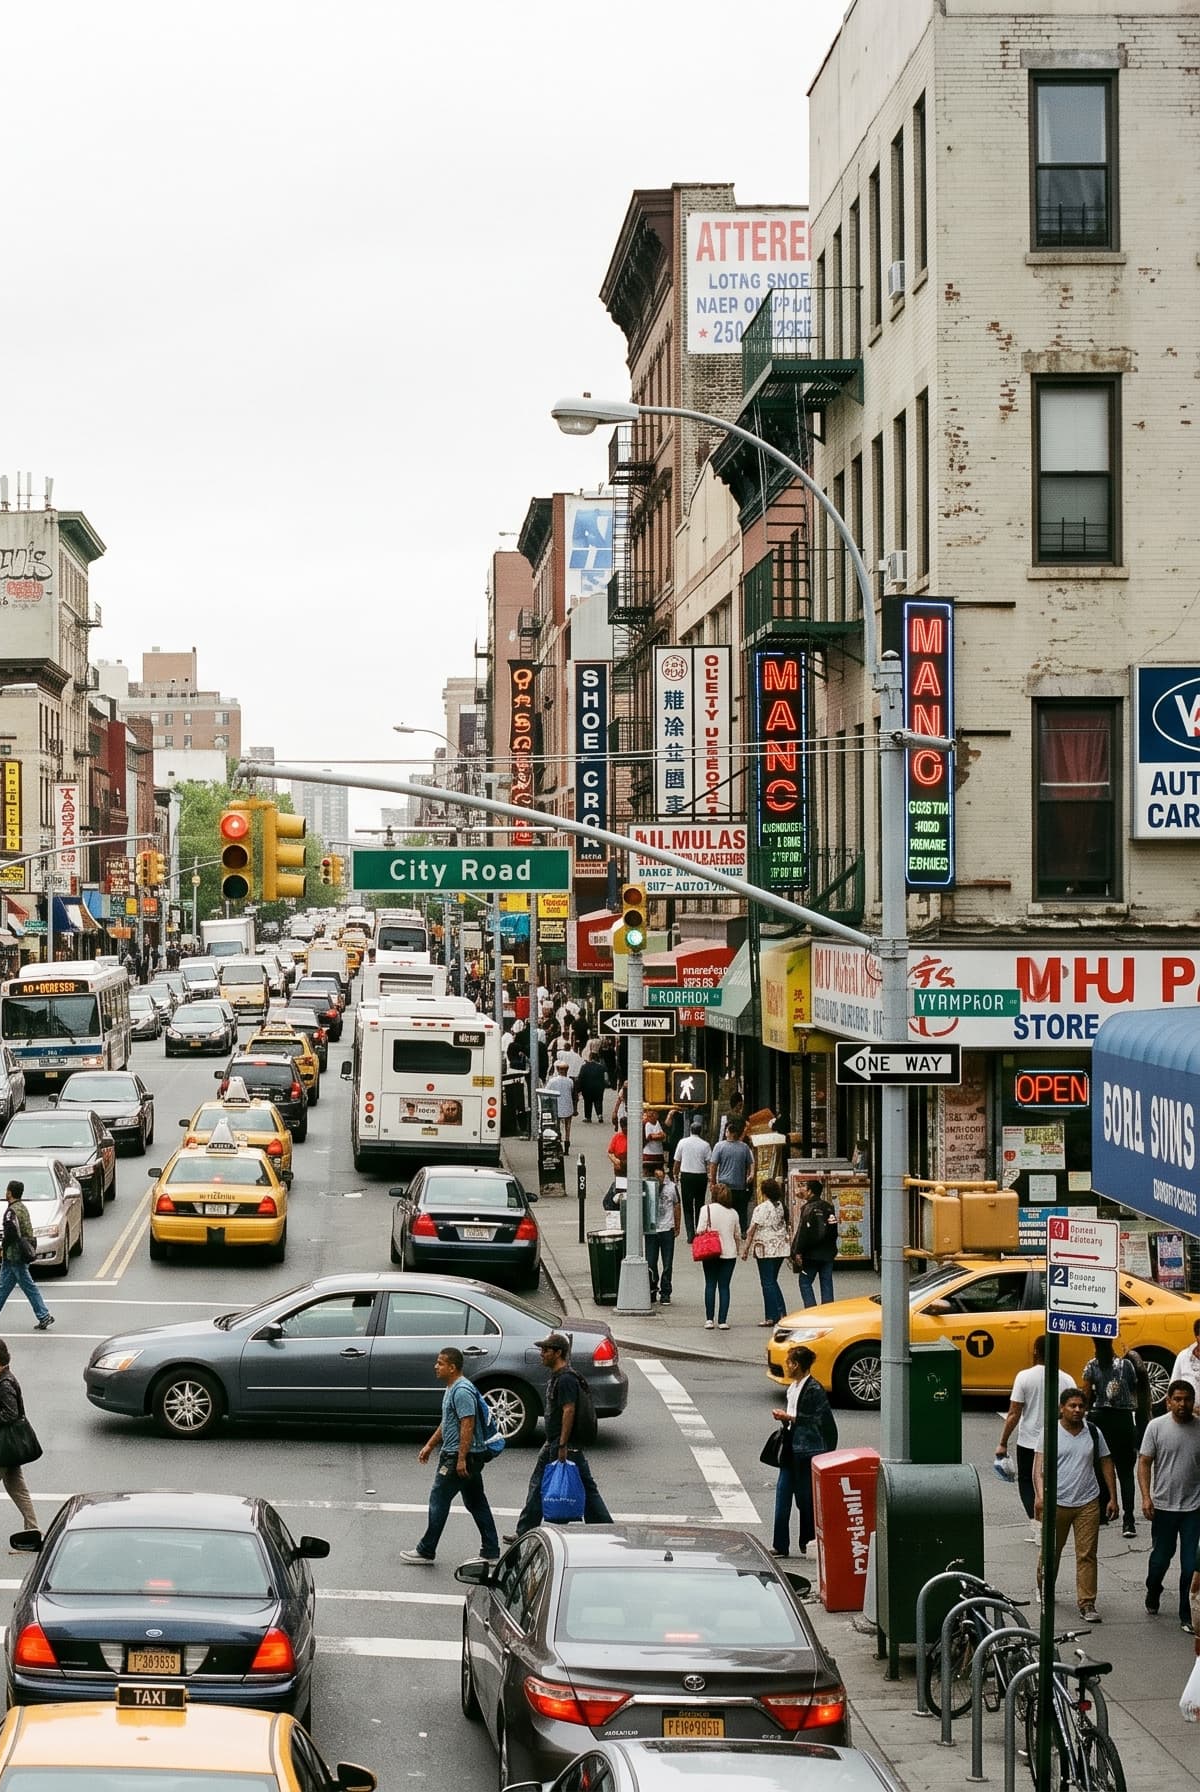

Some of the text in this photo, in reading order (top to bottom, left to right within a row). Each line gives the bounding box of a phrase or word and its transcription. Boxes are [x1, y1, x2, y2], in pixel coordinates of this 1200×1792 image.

[582, 669, 600, 750] SHOE
[389, 859, 531, 887] City Road
[1013, 1013, 1099, 1041] STORE
[855, 1056, 943, 1072] ONE WAY
[1016, 1075, 1087, 1102] OPEN
[1053, 1267, 1065, 1285] 2
[970, 1335, 989, 1356] T
[133, 1689, 167, 1705] TAXI
